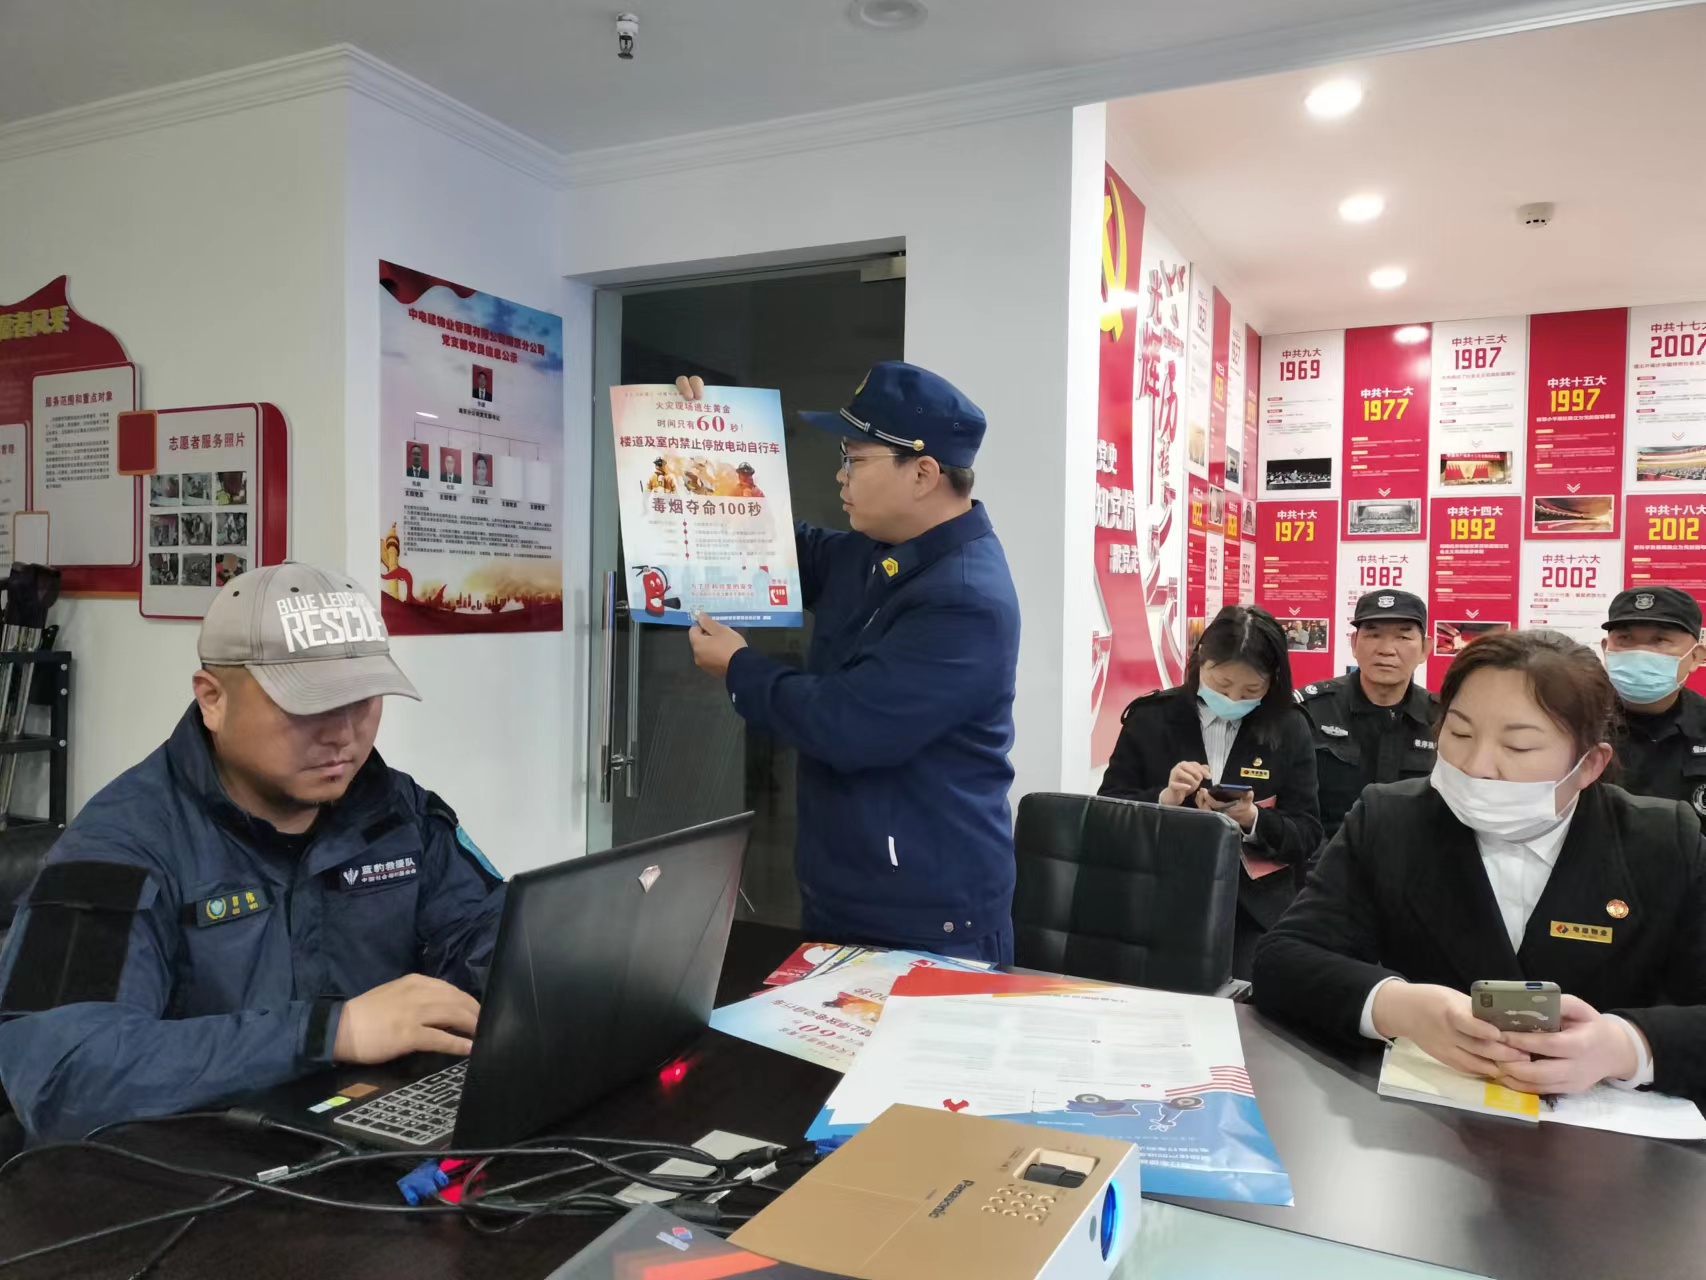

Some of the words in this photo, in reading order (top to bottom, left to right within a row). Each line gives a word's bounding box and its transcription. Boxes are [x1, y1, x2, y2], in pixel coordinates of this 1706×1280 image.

[1451, 334, 1507, 347] 中共十三大
[1651, 333, 1706, 358] 2007
[1282, 348, 1322, 359] 中共九大
[1455, 347, 1502, 370] 1987
[1280, 359, 1320, 381] 1969
[1547, 375, 1607, 388] 中共十五大
[1360, 386, 1414, 399] 中共十一大
[1551, 388, 1600, 412] 1997
[656, 401, 731, 414] 火灾现场逃生黄金
[1364, 398, 1409, 421] 1977
[169, 432, 245, 451] 志愿者服务照片
[620, 436, 780, 455] 楼道及室内禁止停放电动自行车
[652, 498, 762, 516] 毒烟夺命100秒
[1277, 510, 1318, 520] 中共十大
[1447, 506, 1503, 516] 中共十四大
[1645, 504, 1706, 516] 中共十八大
[1275, 521, 1315, 542] 1973
[1450, 518, 1496, 540] 1992
[1648, 517, 1700, 541] 2012
[1357, 554, 1409, 564] 中共十二大
[1542, 554, 1601, 564] 中共十六大
[1360, 566, 1403, 586] 1982
[1542, 567, 1597, 588] 2002
[276, 594, 319, 615] BLUE
[280, 606, 386, 653] RESCUE
